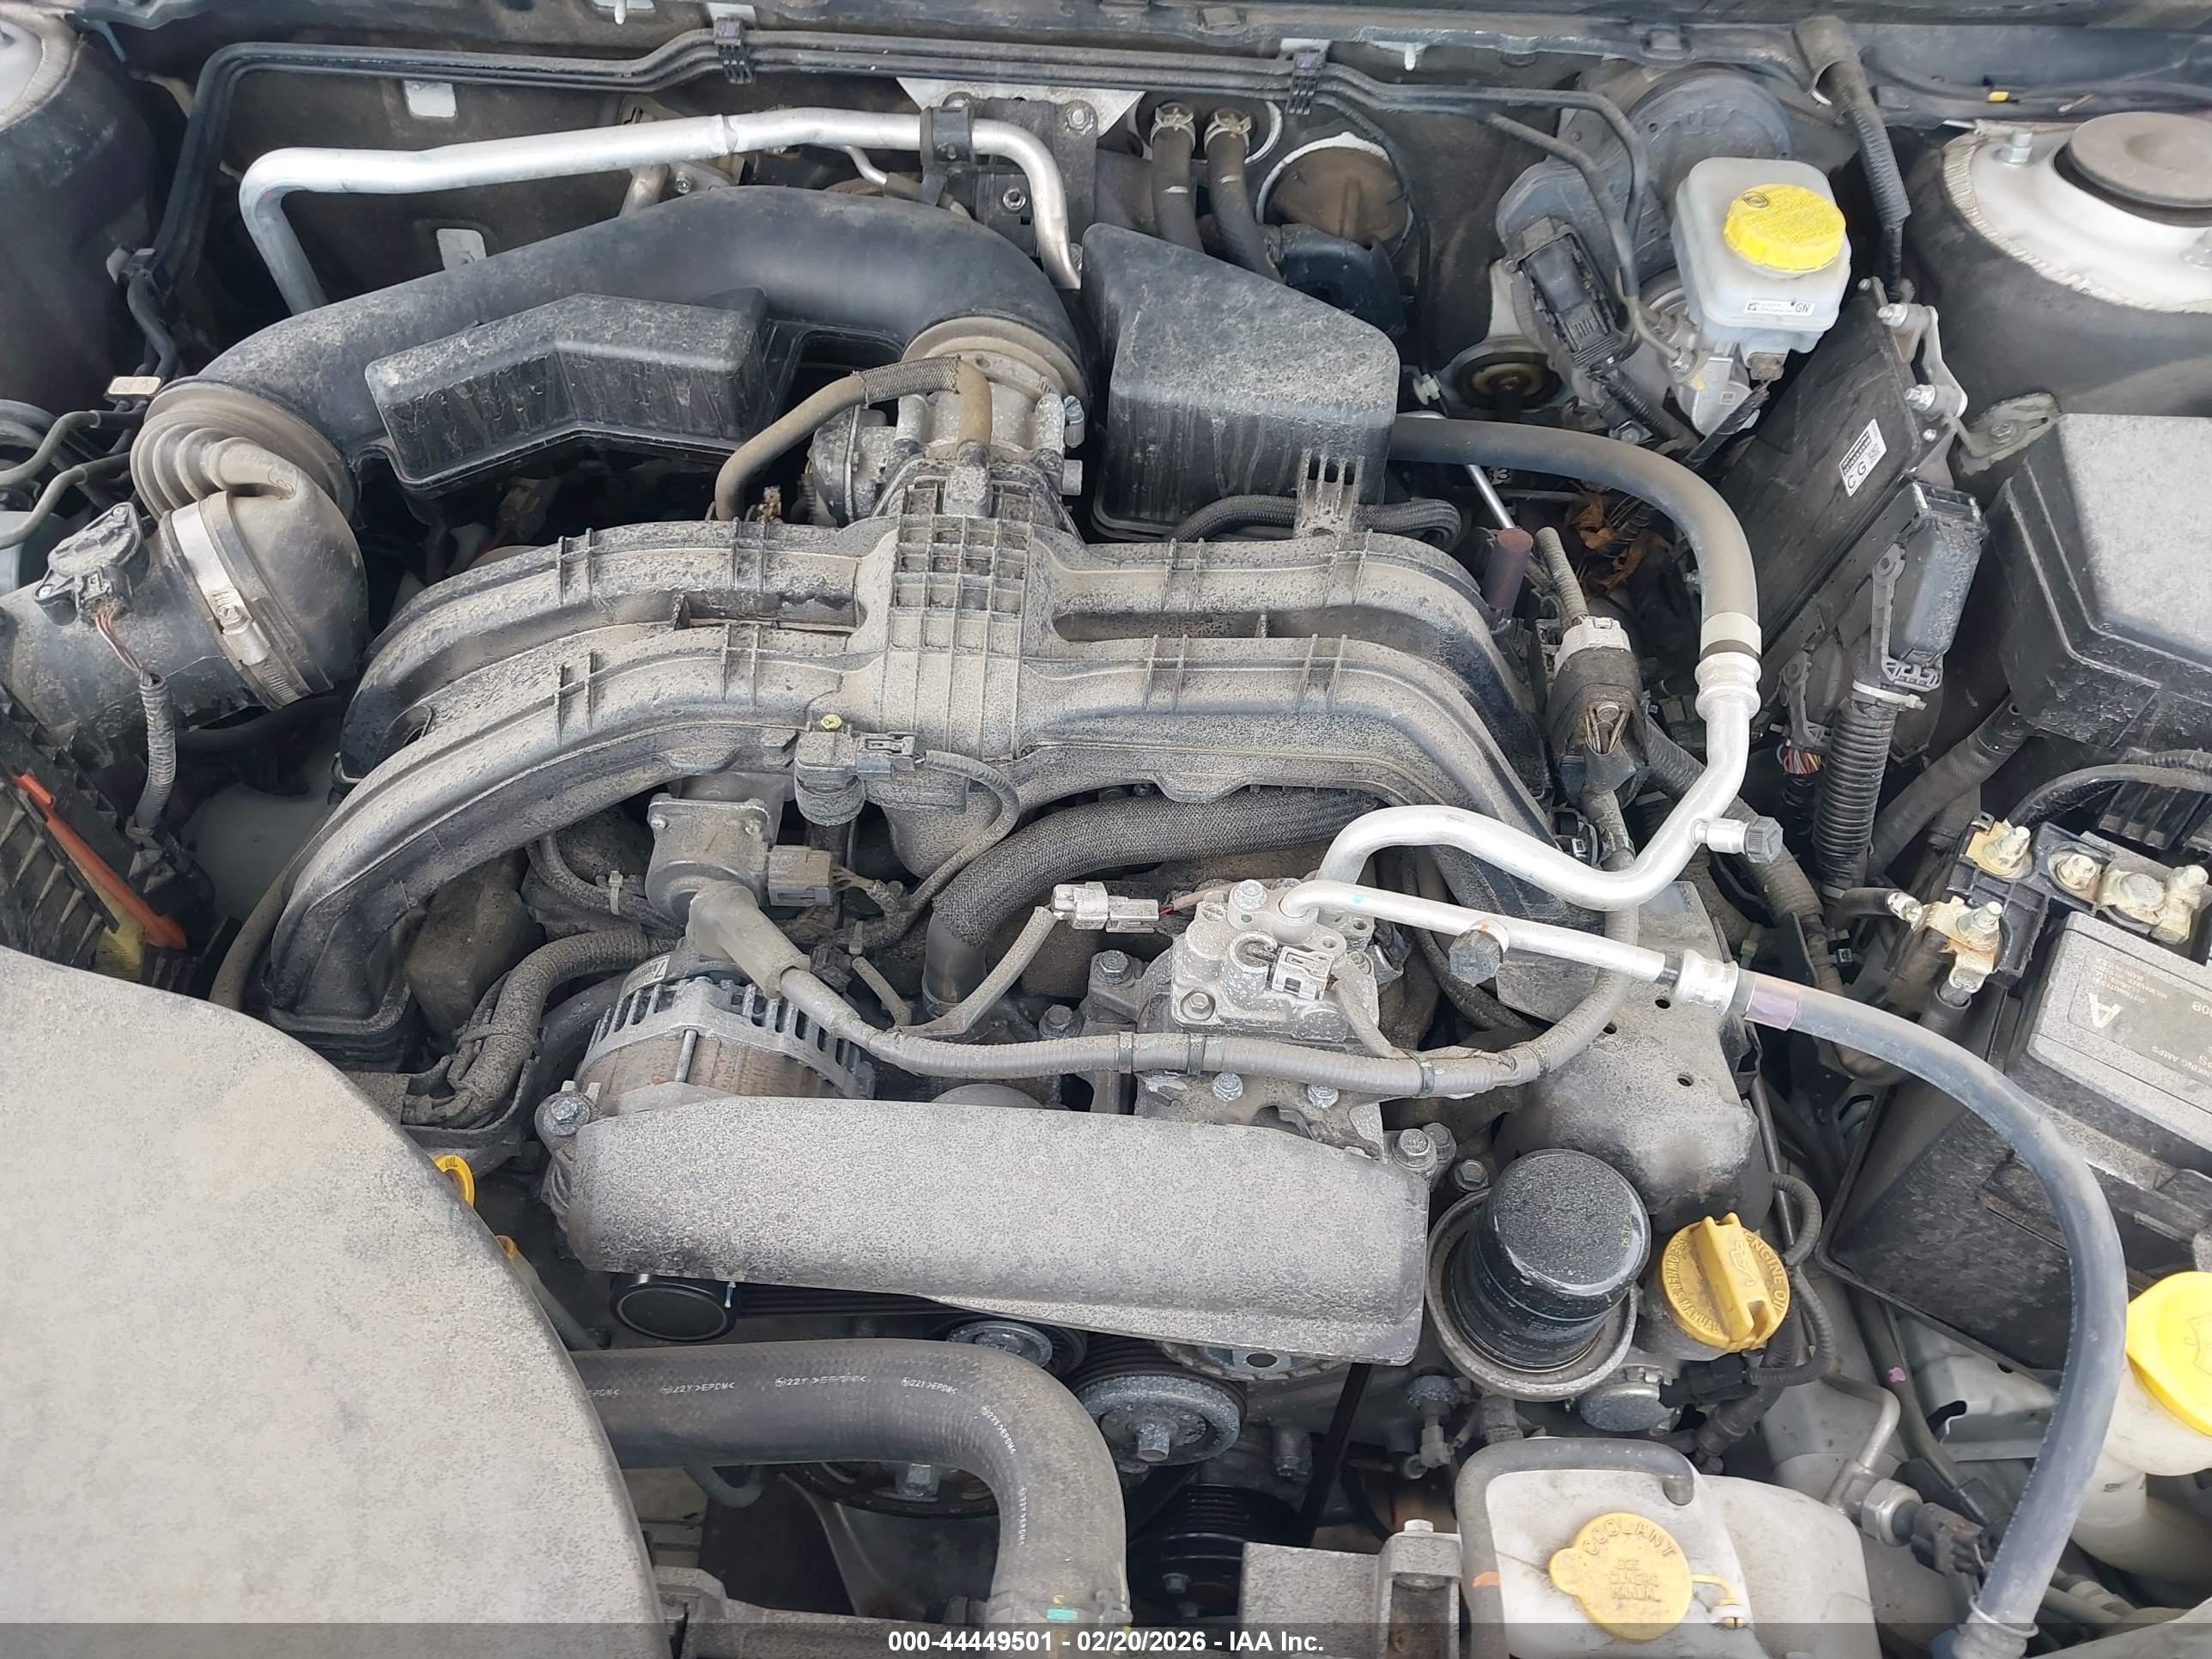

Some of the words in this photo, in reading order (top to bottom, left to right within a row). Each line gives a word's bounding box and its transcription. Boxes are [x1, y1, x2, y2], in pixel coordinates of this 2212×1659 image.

[1795, 302, 1811, 313] GN
[2151, 1045, 2179, 1063] AMPS
[1744, 1231, 1784, 1285] ENGINE
[1679, 1298, 1719, 1334] MANUAL
[1583, 1519, 1677, 1557] COOLANT
